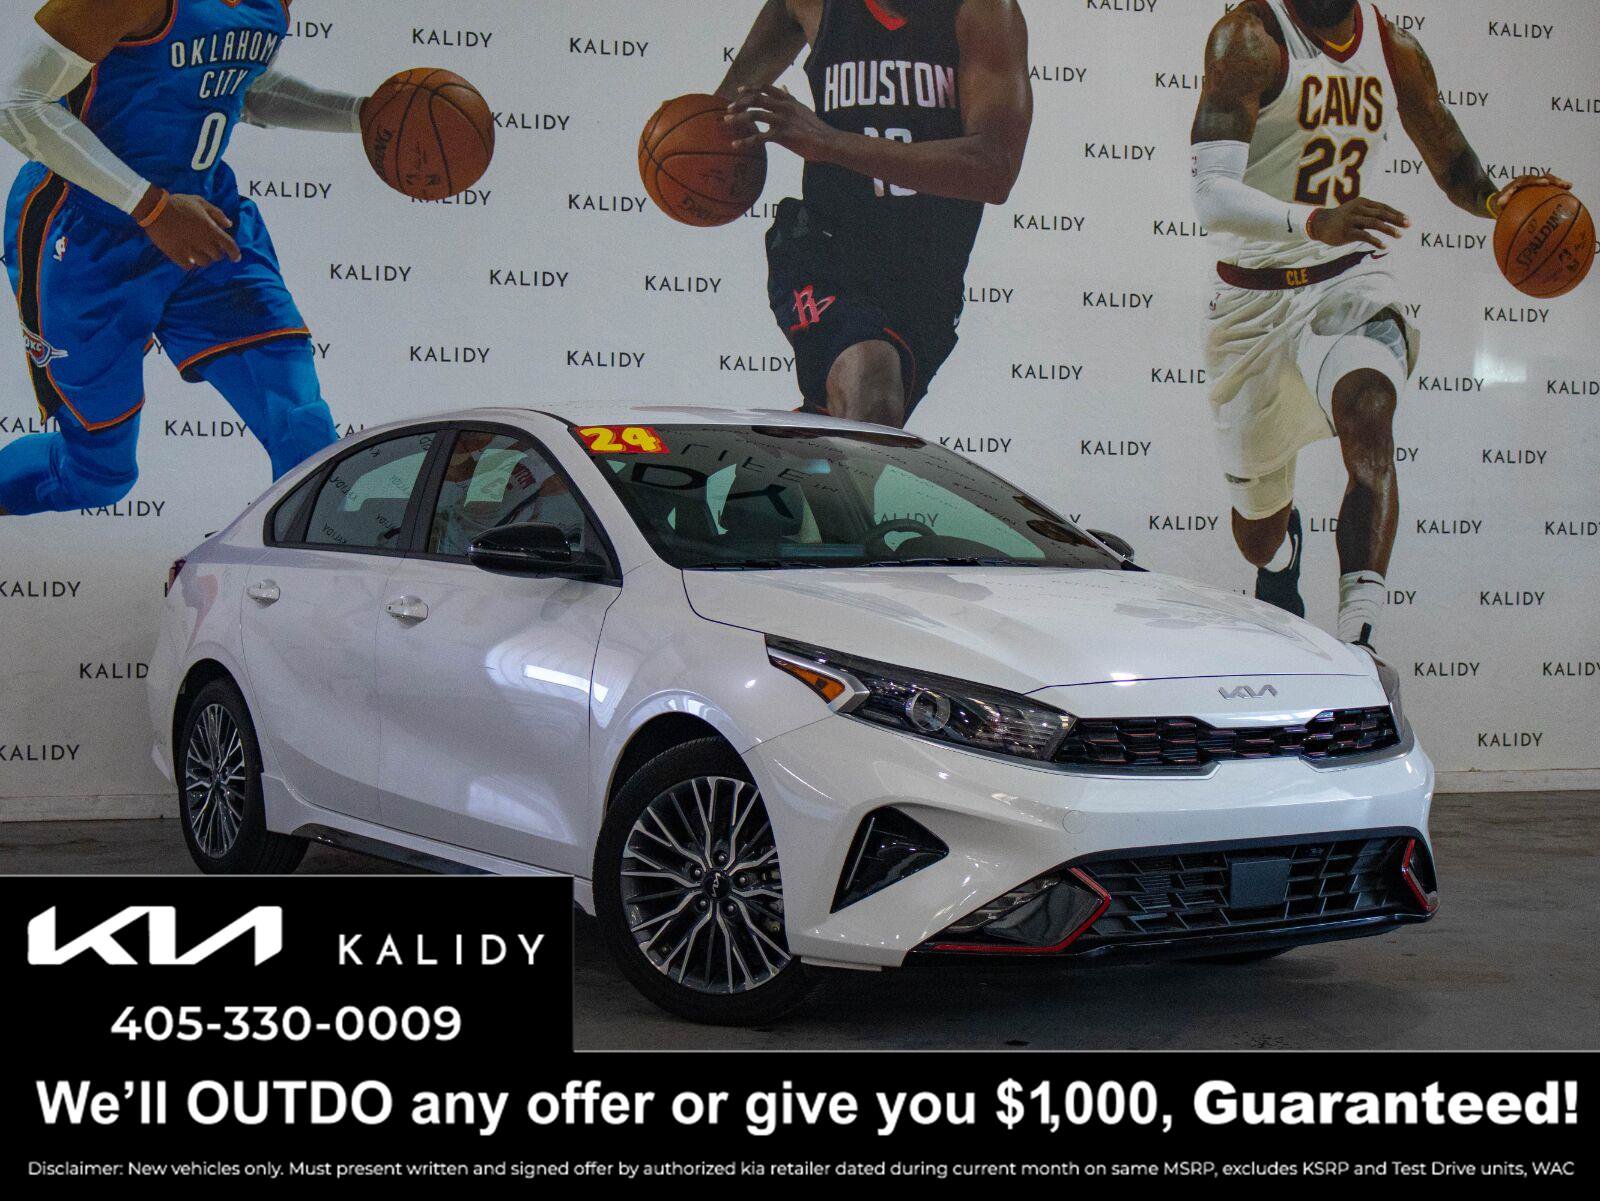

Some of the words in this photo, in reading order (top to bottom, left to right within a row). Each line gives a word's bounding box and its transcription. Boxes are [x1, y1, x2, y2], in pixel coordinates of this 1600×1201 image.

[413, 28, 492, 48] KALIDY
[1489, 22, 1553, 39] KALIDY
[171, 30, 278, 68] OKLAHOM
[570, 37, 648, 57] KALIDY
[1029, 65, 1087, 82] ALIDY
[199, 69, 249, 99] CITY
[824, 60, 957, 112] HOUSTON
[1298, 75, 1383, 132] CAVS
[1437, 90, 1488, 106] ALIDY
[1552, 97, 1600, 113] KALID
[493, 112, 569, 131] KALIDY
[191, 112, 227, 171] 0
[1085, 143, 1155, 160] KALIDY
[1293, 137, 1369, 207] 23
[249, 180, 331, 200] KALIDY
[569, 194, 647, 212] KALIDY
[1014, 214, 1085, 231] KALIDY
[1421, 233, 1486, 249] KALIDY
[330, 264, 411, 282] KALIDY
[490, 269, 568, 287] KALIDY
[1286, 268, 1308, 286] CLE
[645, 275, 721, 293] KALIDY
[963, 287, 1014, 303] LIDY
[1083, 292, 1153, 308] KALIDY
[1485, 307, 1549, 322] KALIDY
[410, 346, 490, 363] KALIDY
[567, 350, 645, 367] KALIDY
[720, 355, 794, 372] KALIDY
[1012, 364, 1082, 380] KALIDY
[1152, 368, 1206, 384] KALID
[1419, 376, 1484, 392] KALIDY
[1547, 380, 1600, 395] KALID
[165, 418, 245, 437] KALIDY
[579, 427, 657, 453] 24
[1081, 440, 1151, 456] KALIDY
[1483, 450, 1547, 464] KALIDY
[1149, 516, 1218, 530] KALIDY
[1417, 520, 1482, 534] KALIDY
[1545, 522, 1600, 536] KALID
[1480, 591, 1544, 605] KALIDY
[80, 663, 148, 679] KALID
[1415, 662, 1479, 676] KALIDY
[1478, 733, 1542, 747] KALIDY
